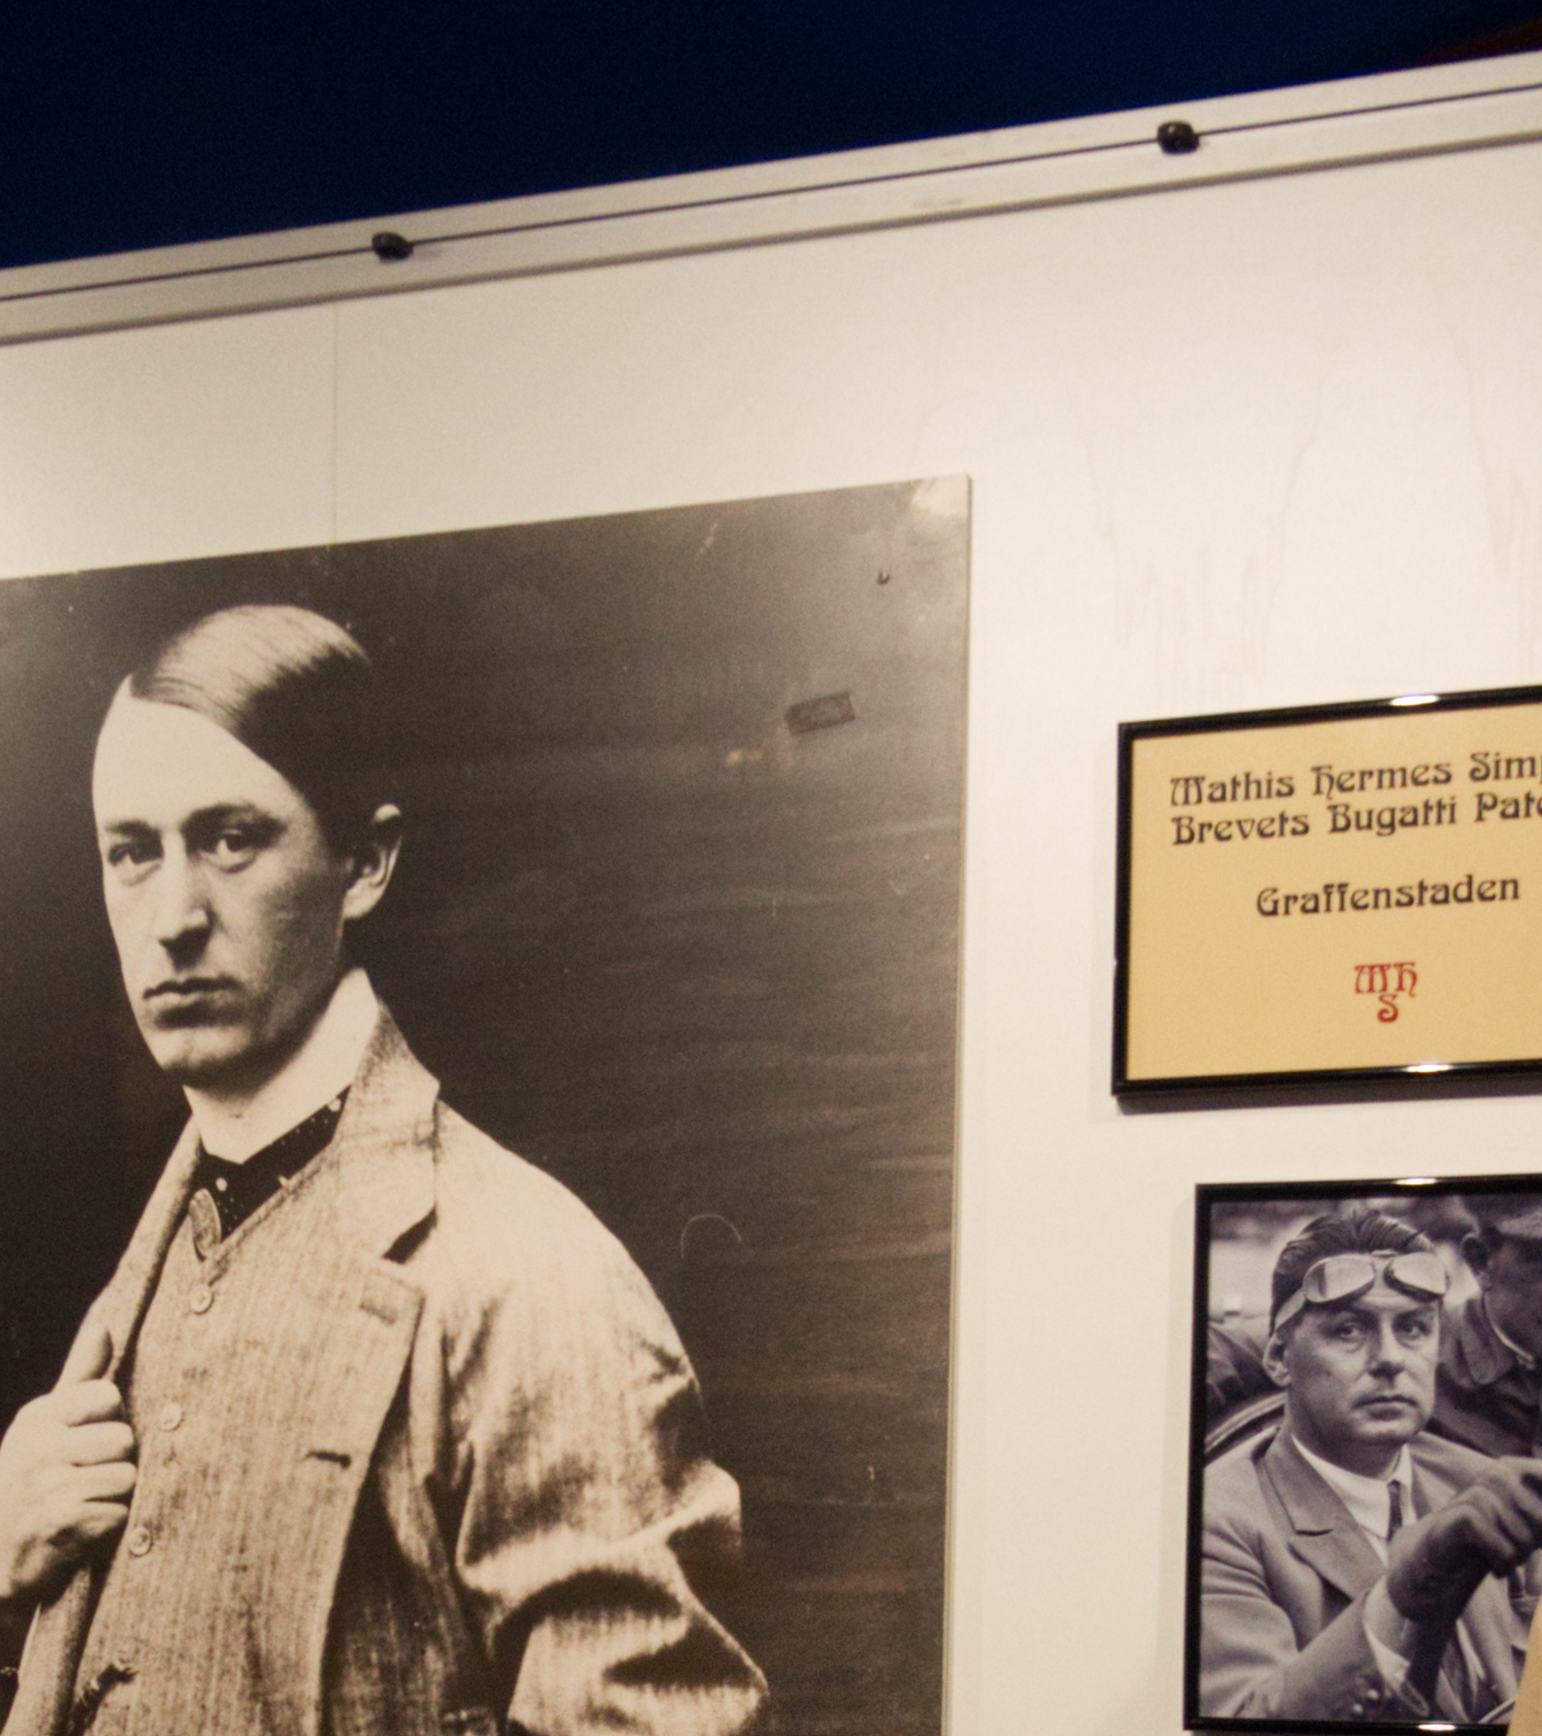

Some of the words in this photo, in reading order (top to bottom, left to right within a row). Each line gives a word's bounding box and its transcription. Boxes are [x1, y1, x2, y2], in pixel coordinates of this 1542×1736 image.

[1170, 771, 1295, 807] Mathis
[1311, 759, 1452, 801] Hermes
[1171, 811, 1311, 846] Brevets
[1326, 796, 1458, 837] Bugatti
[1256, 874, 1521, 918] Graffenstaden
